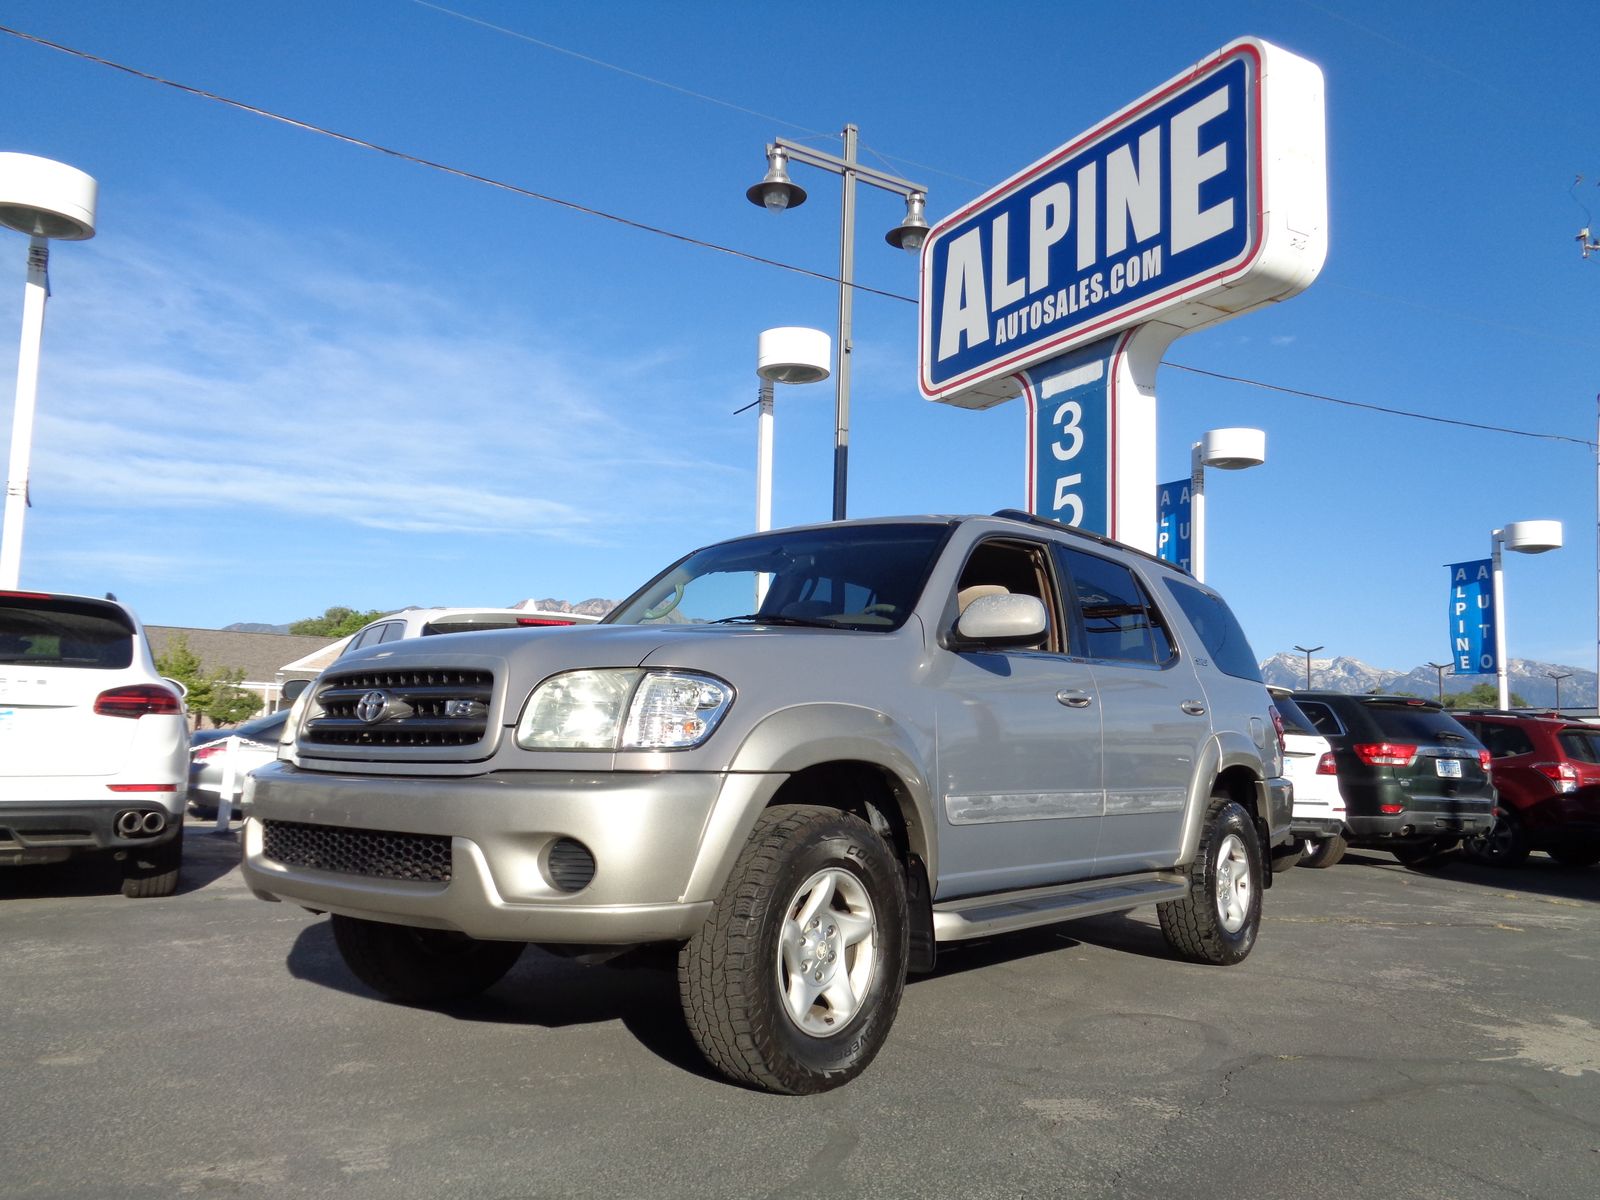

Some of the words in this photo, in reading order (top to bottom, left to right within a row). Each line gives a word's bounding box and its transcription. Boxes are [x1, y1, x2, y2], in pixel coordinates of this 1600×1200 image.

[938, 84, 1234, 362] ALPINE
[996, 246, 1162, 346] AUTOSALES.COM
[1455, 567, 1470, 670] ALPINE
[1477, 565, 1493, 669] AUTO
